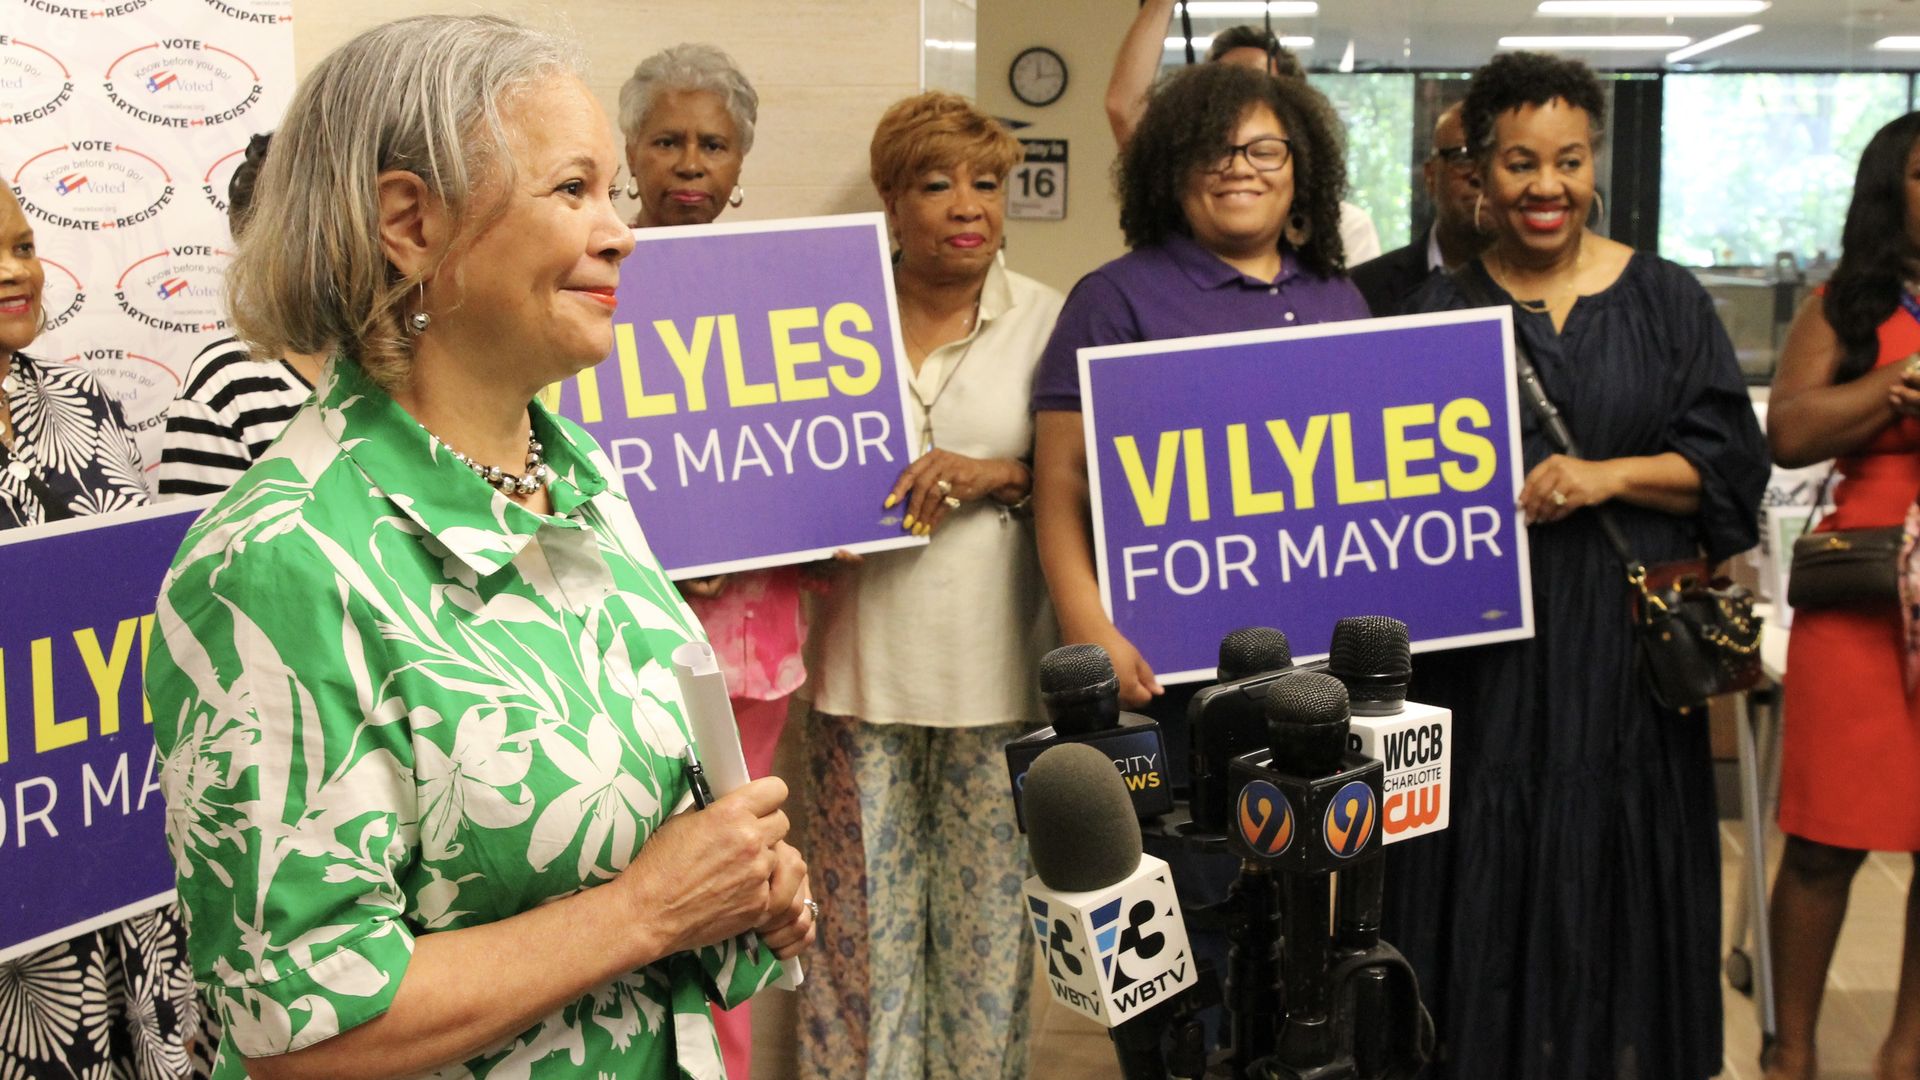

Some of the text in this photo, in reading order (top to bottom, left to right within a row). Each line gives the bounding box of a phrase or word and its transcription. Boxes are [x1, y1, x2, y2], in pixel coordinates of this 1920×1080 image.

[23, 0, 151, 19] ICIPATE REGIS
[162, 38, 202, 51] VOTE
[3, 56, 23, 68] you
[134, 60, 161, 80] Know
[162, 57, 194, 68] before
[195, 60, 214, 73] you
[0, 76, 23, 89] ted
[177, 79, 214, 92] Voted
[13, 81, 75, 125] REGISTER
[103, 82, 264, 129] PARTICIPATE REGISTER
[71, 140, 112, 152] VOTE
[43, 165, 70, 183] Know
[72, 159, 105, 170] before
[107, 161, 126, 174] you
[1017, 168, 1056, 197] 16
[87, 181, 126, 194] Voted
[12, 186, 101, 231] PARTICIPATE
[116, 185, 175, 228] REGISTER
[172, 245, 213, 257] VOTE
[145, 269, 171, 288] Know
[173, 263, 205, 275] before
[46, 292, 87, 332] GISTER
[113, 291, 201, 334] PARTICIPATE
[83, 349, 124, 361] VOTE
[614, 302, 882, 419] LYLES
[119, 368, 139, 382] you
[673, 410, 894, 488] MAYOR
[1113, 397, 1497, 527] VI LYLES
[1122, 505, 1503, 601] FOR MAYOR
[1383, 723, 1443, 772] WCCB
[1124, 771, 1161, 792] WS
[1383, 767, 1441, 793] CHARLOTTE
[1382, 784, 1441, 835] CW
[1051, 979, 1100, 1016] WBTV
[1113, 961, 1186, 1014] WBTV
